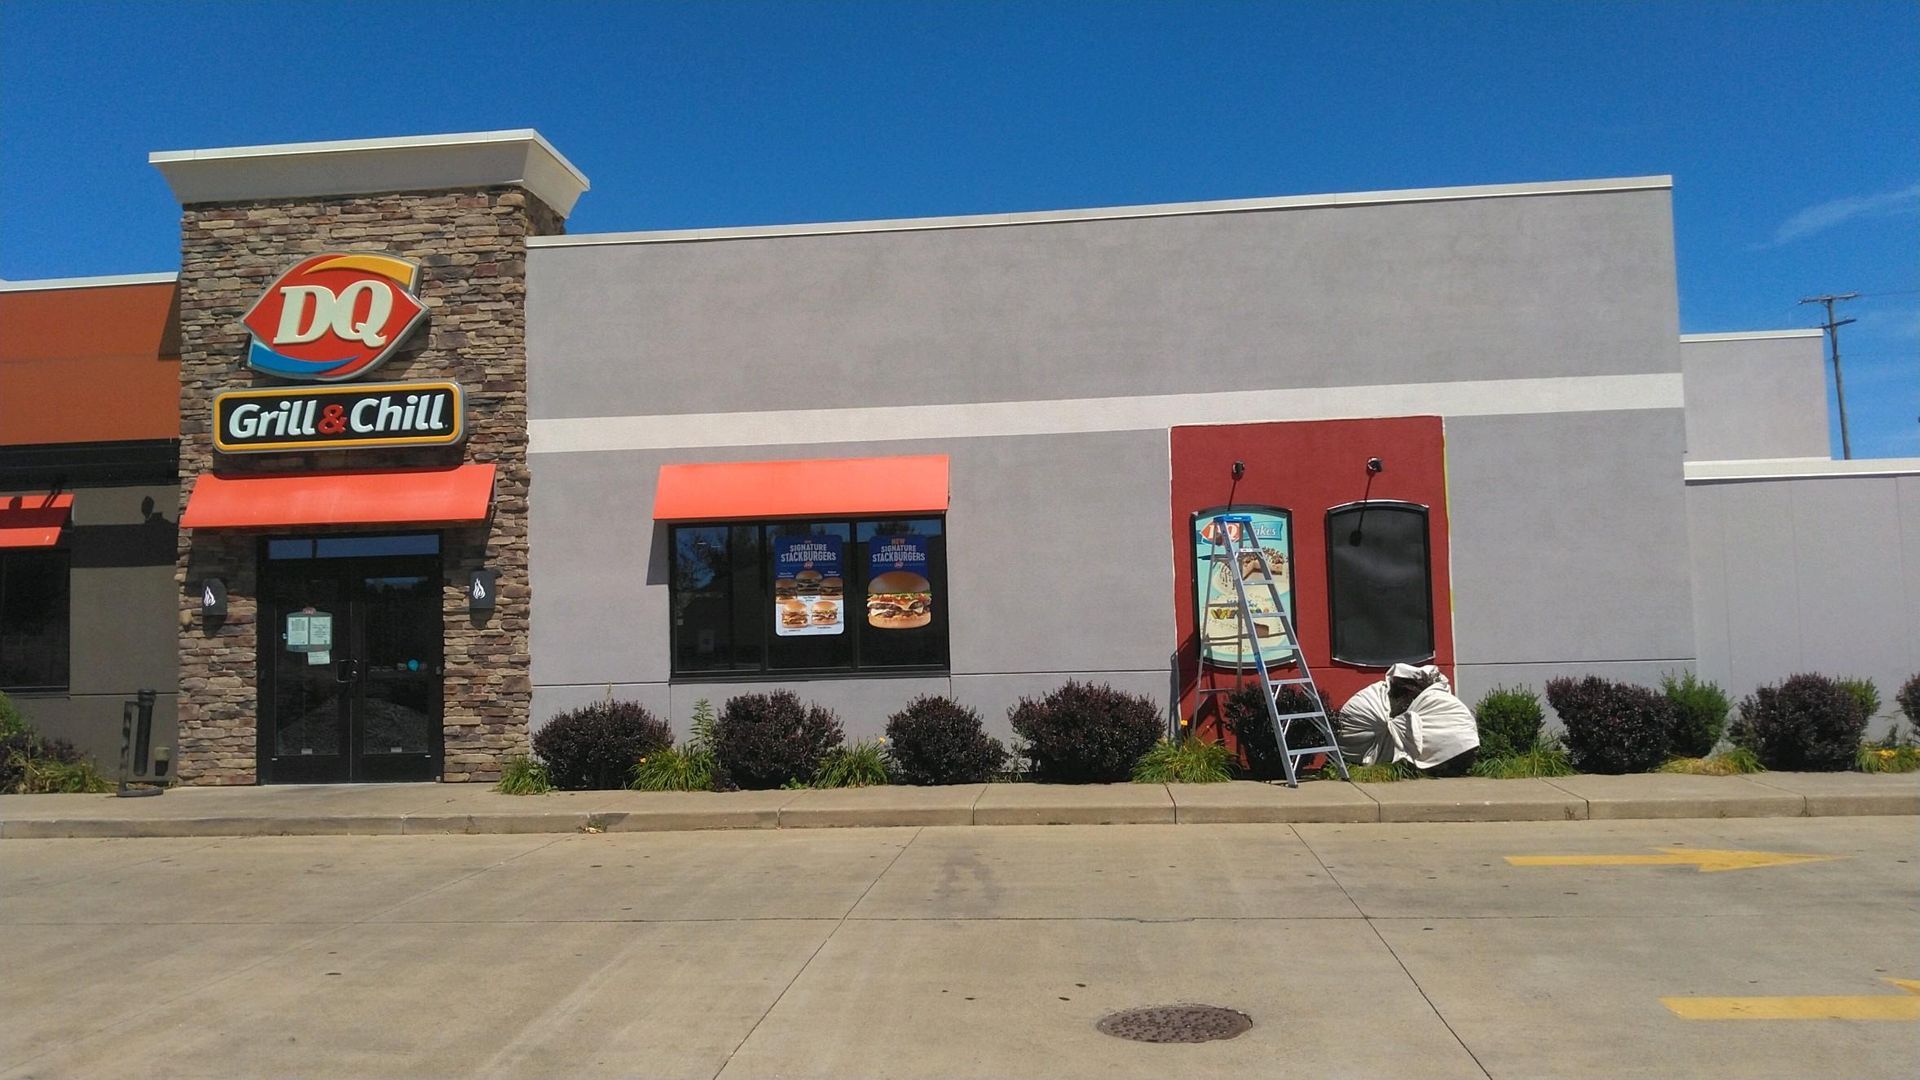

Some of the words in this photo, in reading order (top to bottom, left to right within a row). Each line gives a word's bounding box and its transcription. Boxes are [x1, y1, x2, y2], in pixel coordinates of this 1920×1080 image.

[272, 279, 394, 348] DQ
[228, 399, 318, 439] Grill
[318, 404, 347, 435] &
[349, 394, 446, 434] Chill
[789, 543, 828, 552] SIGNATURE
[880, 544, 917, 552] SIGNATURE
[780, 551, 837, 562] STACKBURGERS
[872, 551, 926, 562] STACKBURGERS
